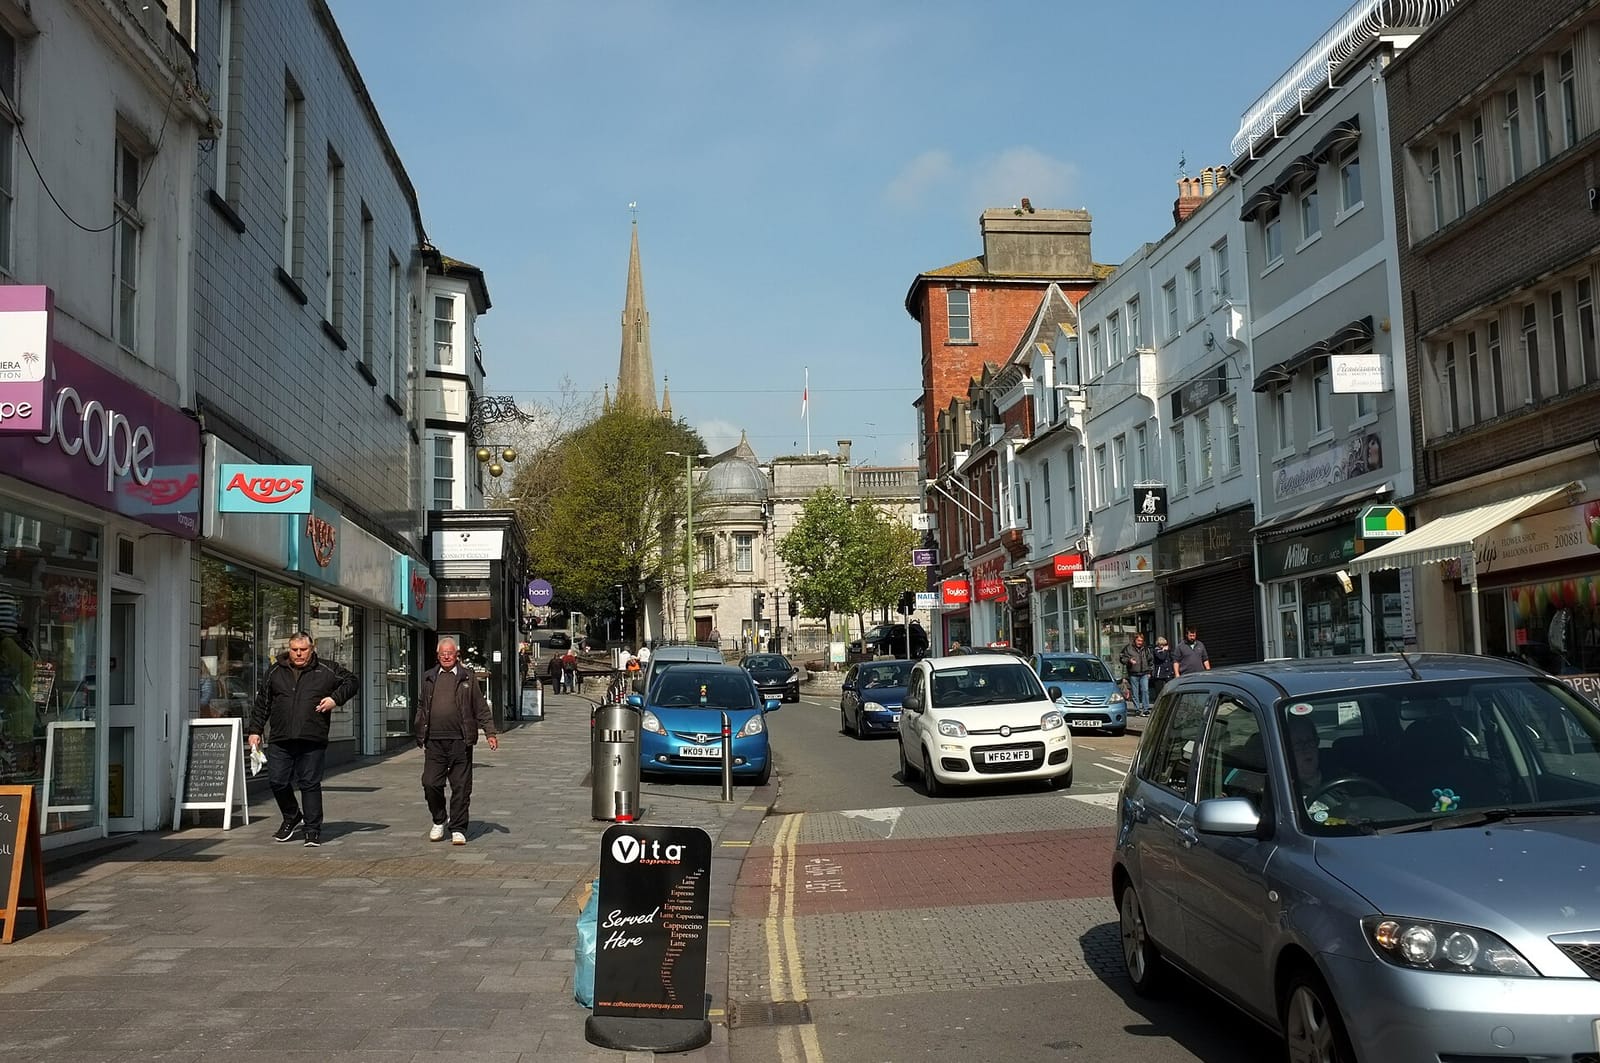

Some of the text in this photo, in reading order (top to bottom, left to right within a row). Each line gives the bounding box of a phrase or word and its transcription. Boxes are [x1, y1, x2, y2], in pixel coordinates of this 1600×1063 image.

[0, 361, 21, 369] IERA
[0, 402, 32, 424] pe
[225, 472, 305, 504] Argos
[176, 511, 196, 531] Torquay
[1137, 514, 1166, 522] TATTOO
[1554, 531, 1583, 549] 200881
[1283, 543, 1309, 569] Miller
[1475, 535, 1498, 573] ily's
[1056, 563, 1083, 571] Connells
[529, 588, 550, 596] haart
[705, 748, 720, 756] YEJ
[988, 750, 1030, 761] WF62 WFB
[612, 835, 681, 863] Vita
[664, 903, 692, 912] Espresso
[602, 907, 660, 928] Served
[663, 921, 702, 931] Cappuccino
[603, 931, 644, 950] Here
[671, 931, 699, 940] Espresso
